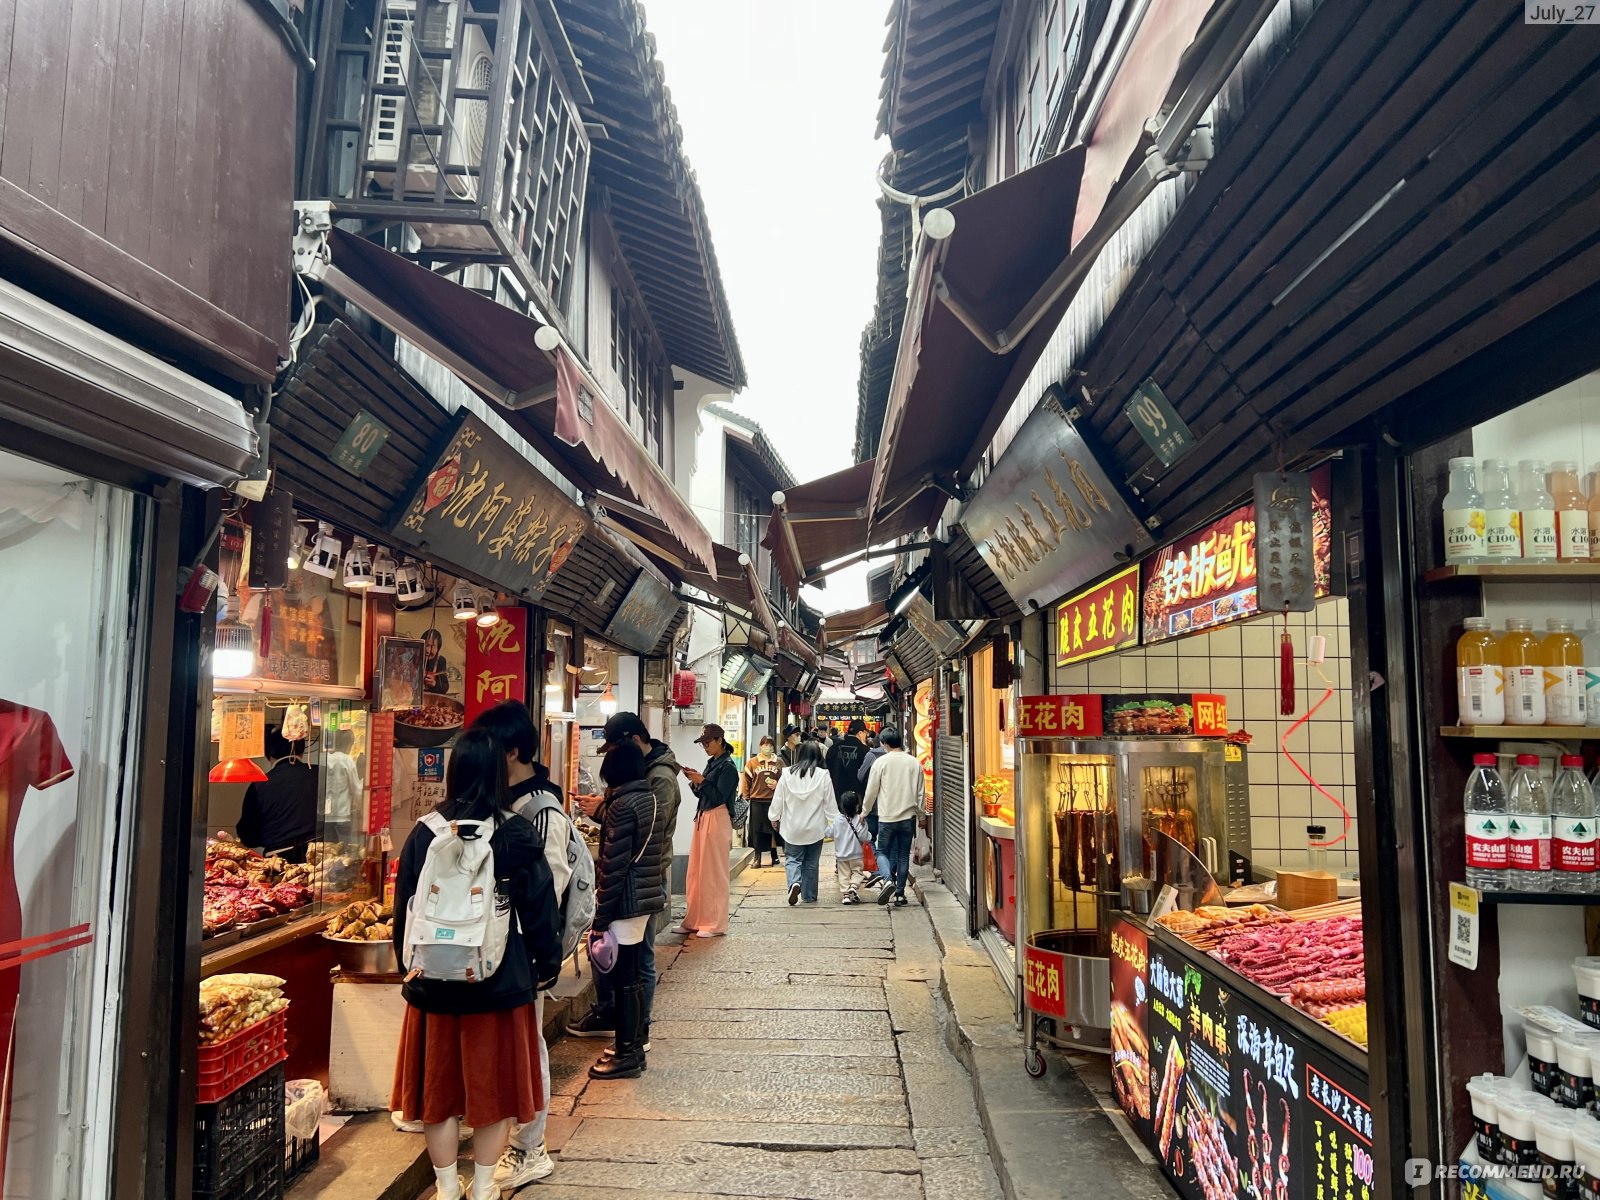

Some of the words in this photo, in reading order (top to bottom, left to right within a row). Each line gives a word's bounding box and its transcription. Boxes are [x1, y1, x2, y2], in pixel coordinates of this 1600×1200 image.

[1136, 396, 1167, 437] 99
[352, 422, 379, 453] 80
[441, 459, 567, 576] 沈阿婆粽子
[1448, 534, 1476, 544] C100
[1488, 534, 1516, 544] C100
[1059, 583, 1135, 656] 脆皮五花肉
[1020, 702, 1085, 731] 五花肉
[1197, 701, 1227, 730] 网红
[1190, 1000, 1227, 1056] 羊肉串
